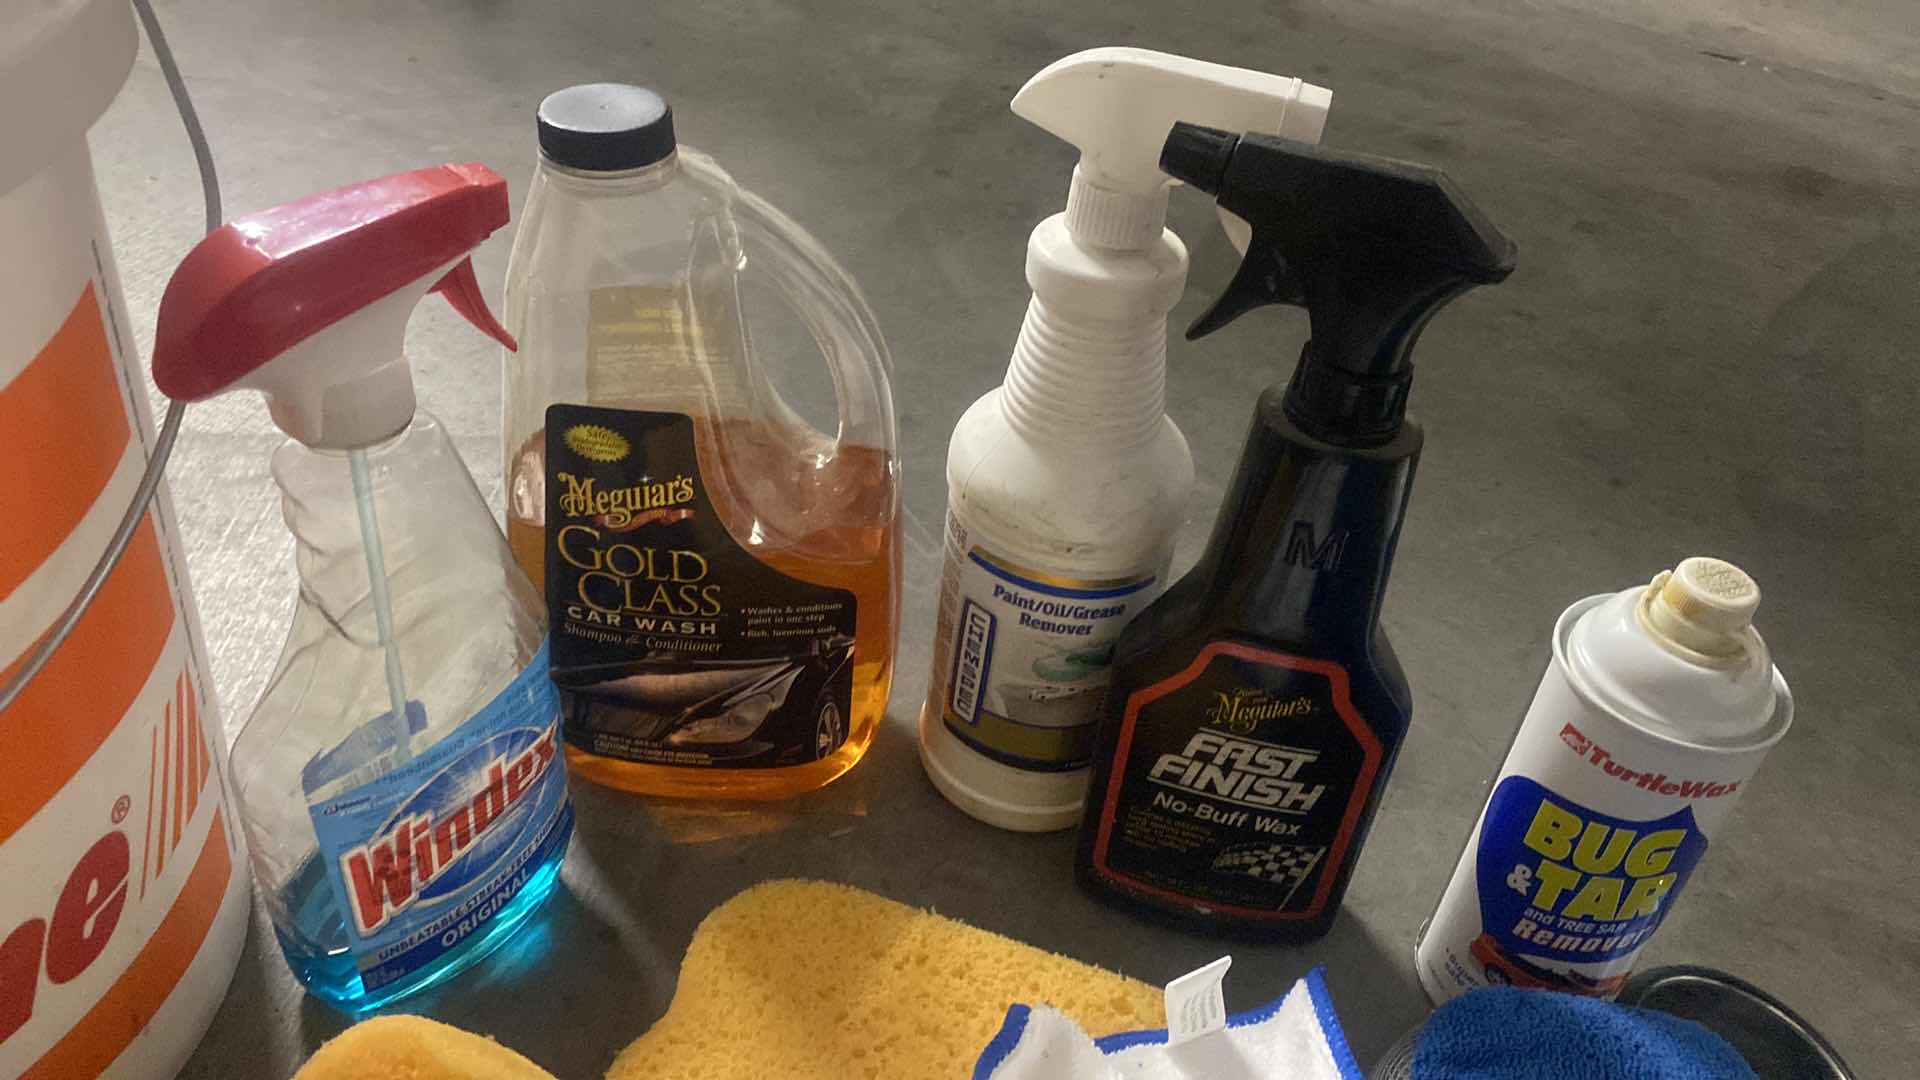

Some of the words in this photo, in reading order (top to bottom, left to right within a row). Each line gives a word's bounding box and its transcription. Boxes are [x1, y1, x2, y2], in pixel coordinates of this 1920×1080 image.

[557, 473, 695, 528] Meguiar's
[558, 525, 709, 581] GOLD
[578, 572, 721, 616] CLASS
[747, 605, 782, 615] Washes
[993, 583, 1126, 621] Paint/Oil/Grease
[562, 622, 622, 646] Shampoo
[626, 633, 641, 646] &
[646, 636, 723, 653] Conditioner
[567, 605, 621, 626] CAR
[635, 617, 717, 636] WASH
[1019, 612, 1094, 636] Remover
[1182, 732, 1320, 780] FAST
[1150, 754, 1325, 811] FINISH
[344, 723, 559, 932] Windex
[1152, 791, 1248, 828] No-Buff
[1255, 815, 1302, 836] Wax
[1523, 799, 1687, 878] BUG
[441, 868, 530, 947] ORIGINAL
[1506, 864, 1532, 897] &
[1532, 861, 1678, 922] TAR
[1512, 918, 1653, 951] Remover
[1523, 908, 1553, 927] and
[1555, 916, 1595, 935] TREE
[1597, 921, 1628, 937] SAP
